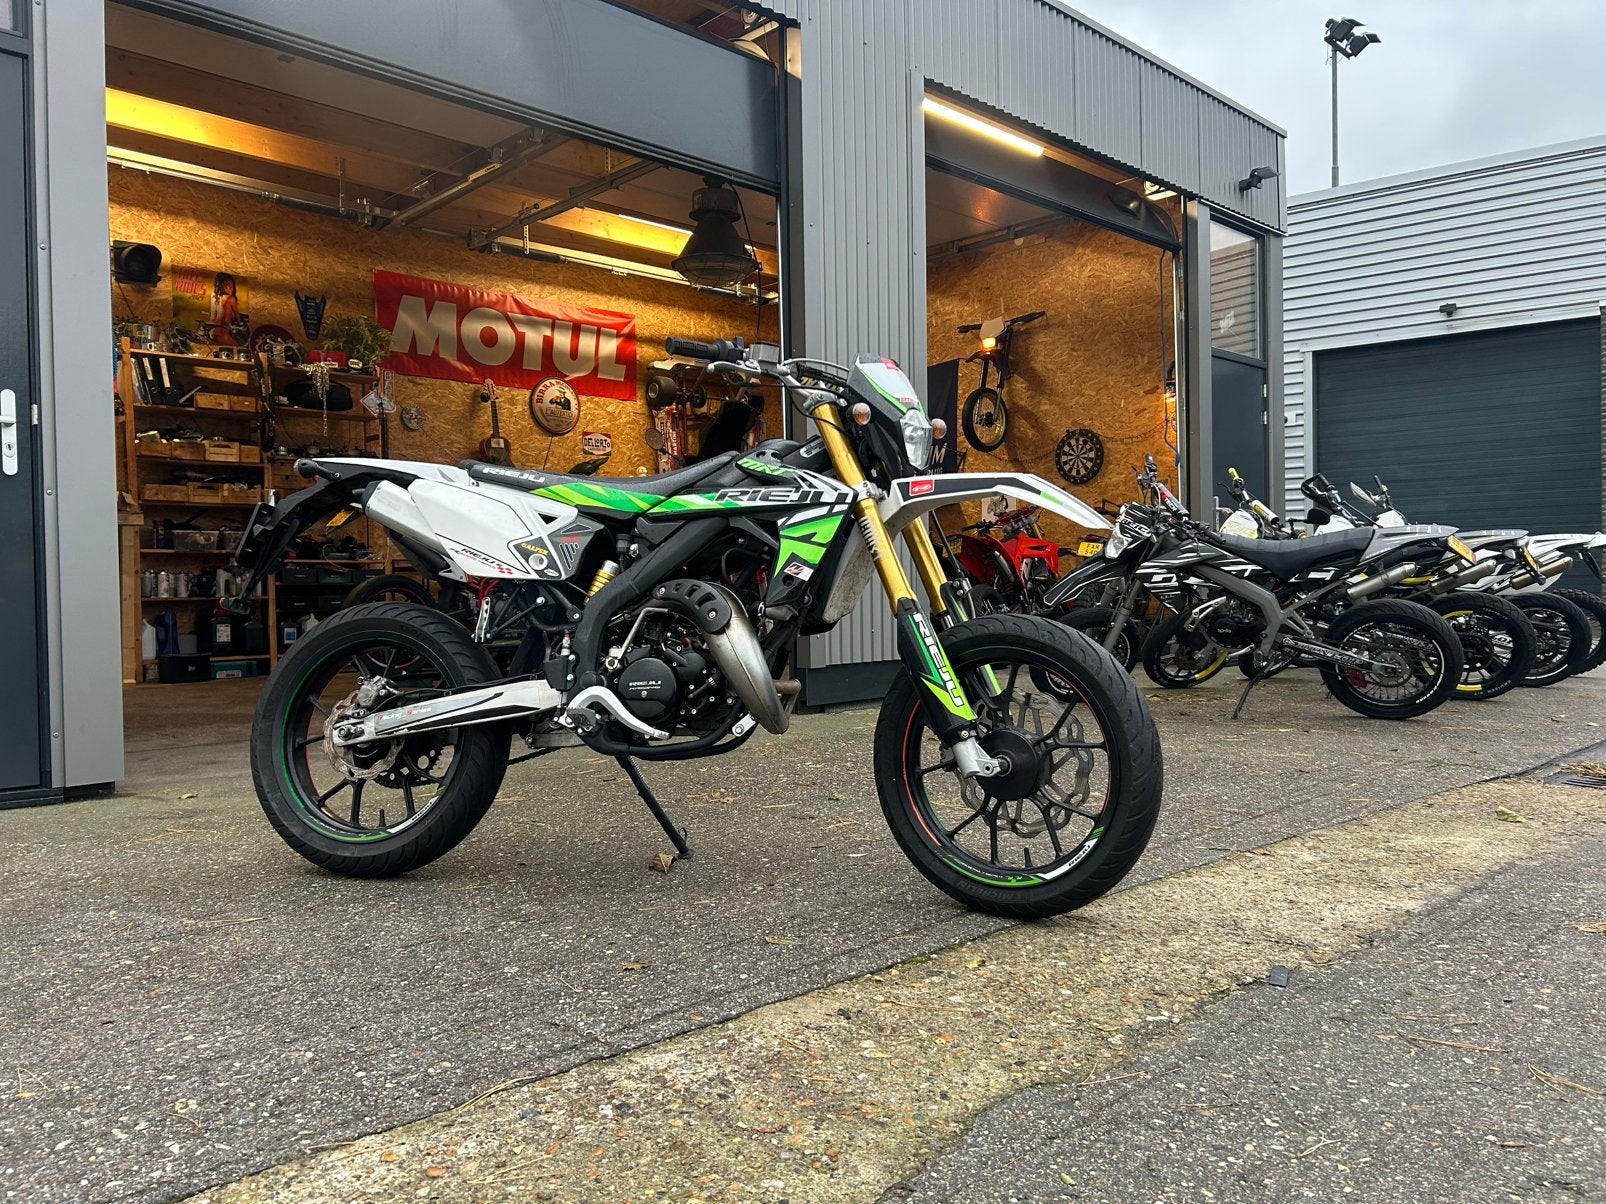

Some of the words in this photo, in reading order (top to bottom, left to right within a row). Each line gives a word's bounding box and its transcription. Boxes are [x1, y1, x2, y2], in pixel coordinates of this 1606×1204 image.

[390, 295, 626, 381] MOTUL
[536, 381, 555, 404] BIRRA
[482, 467, 546, 483] RIEJU
[715, 488, 851, 503] RIEJU
[461, 548, 496, 564] RIEJU
[913, 611, 964, 708] RIEJU
